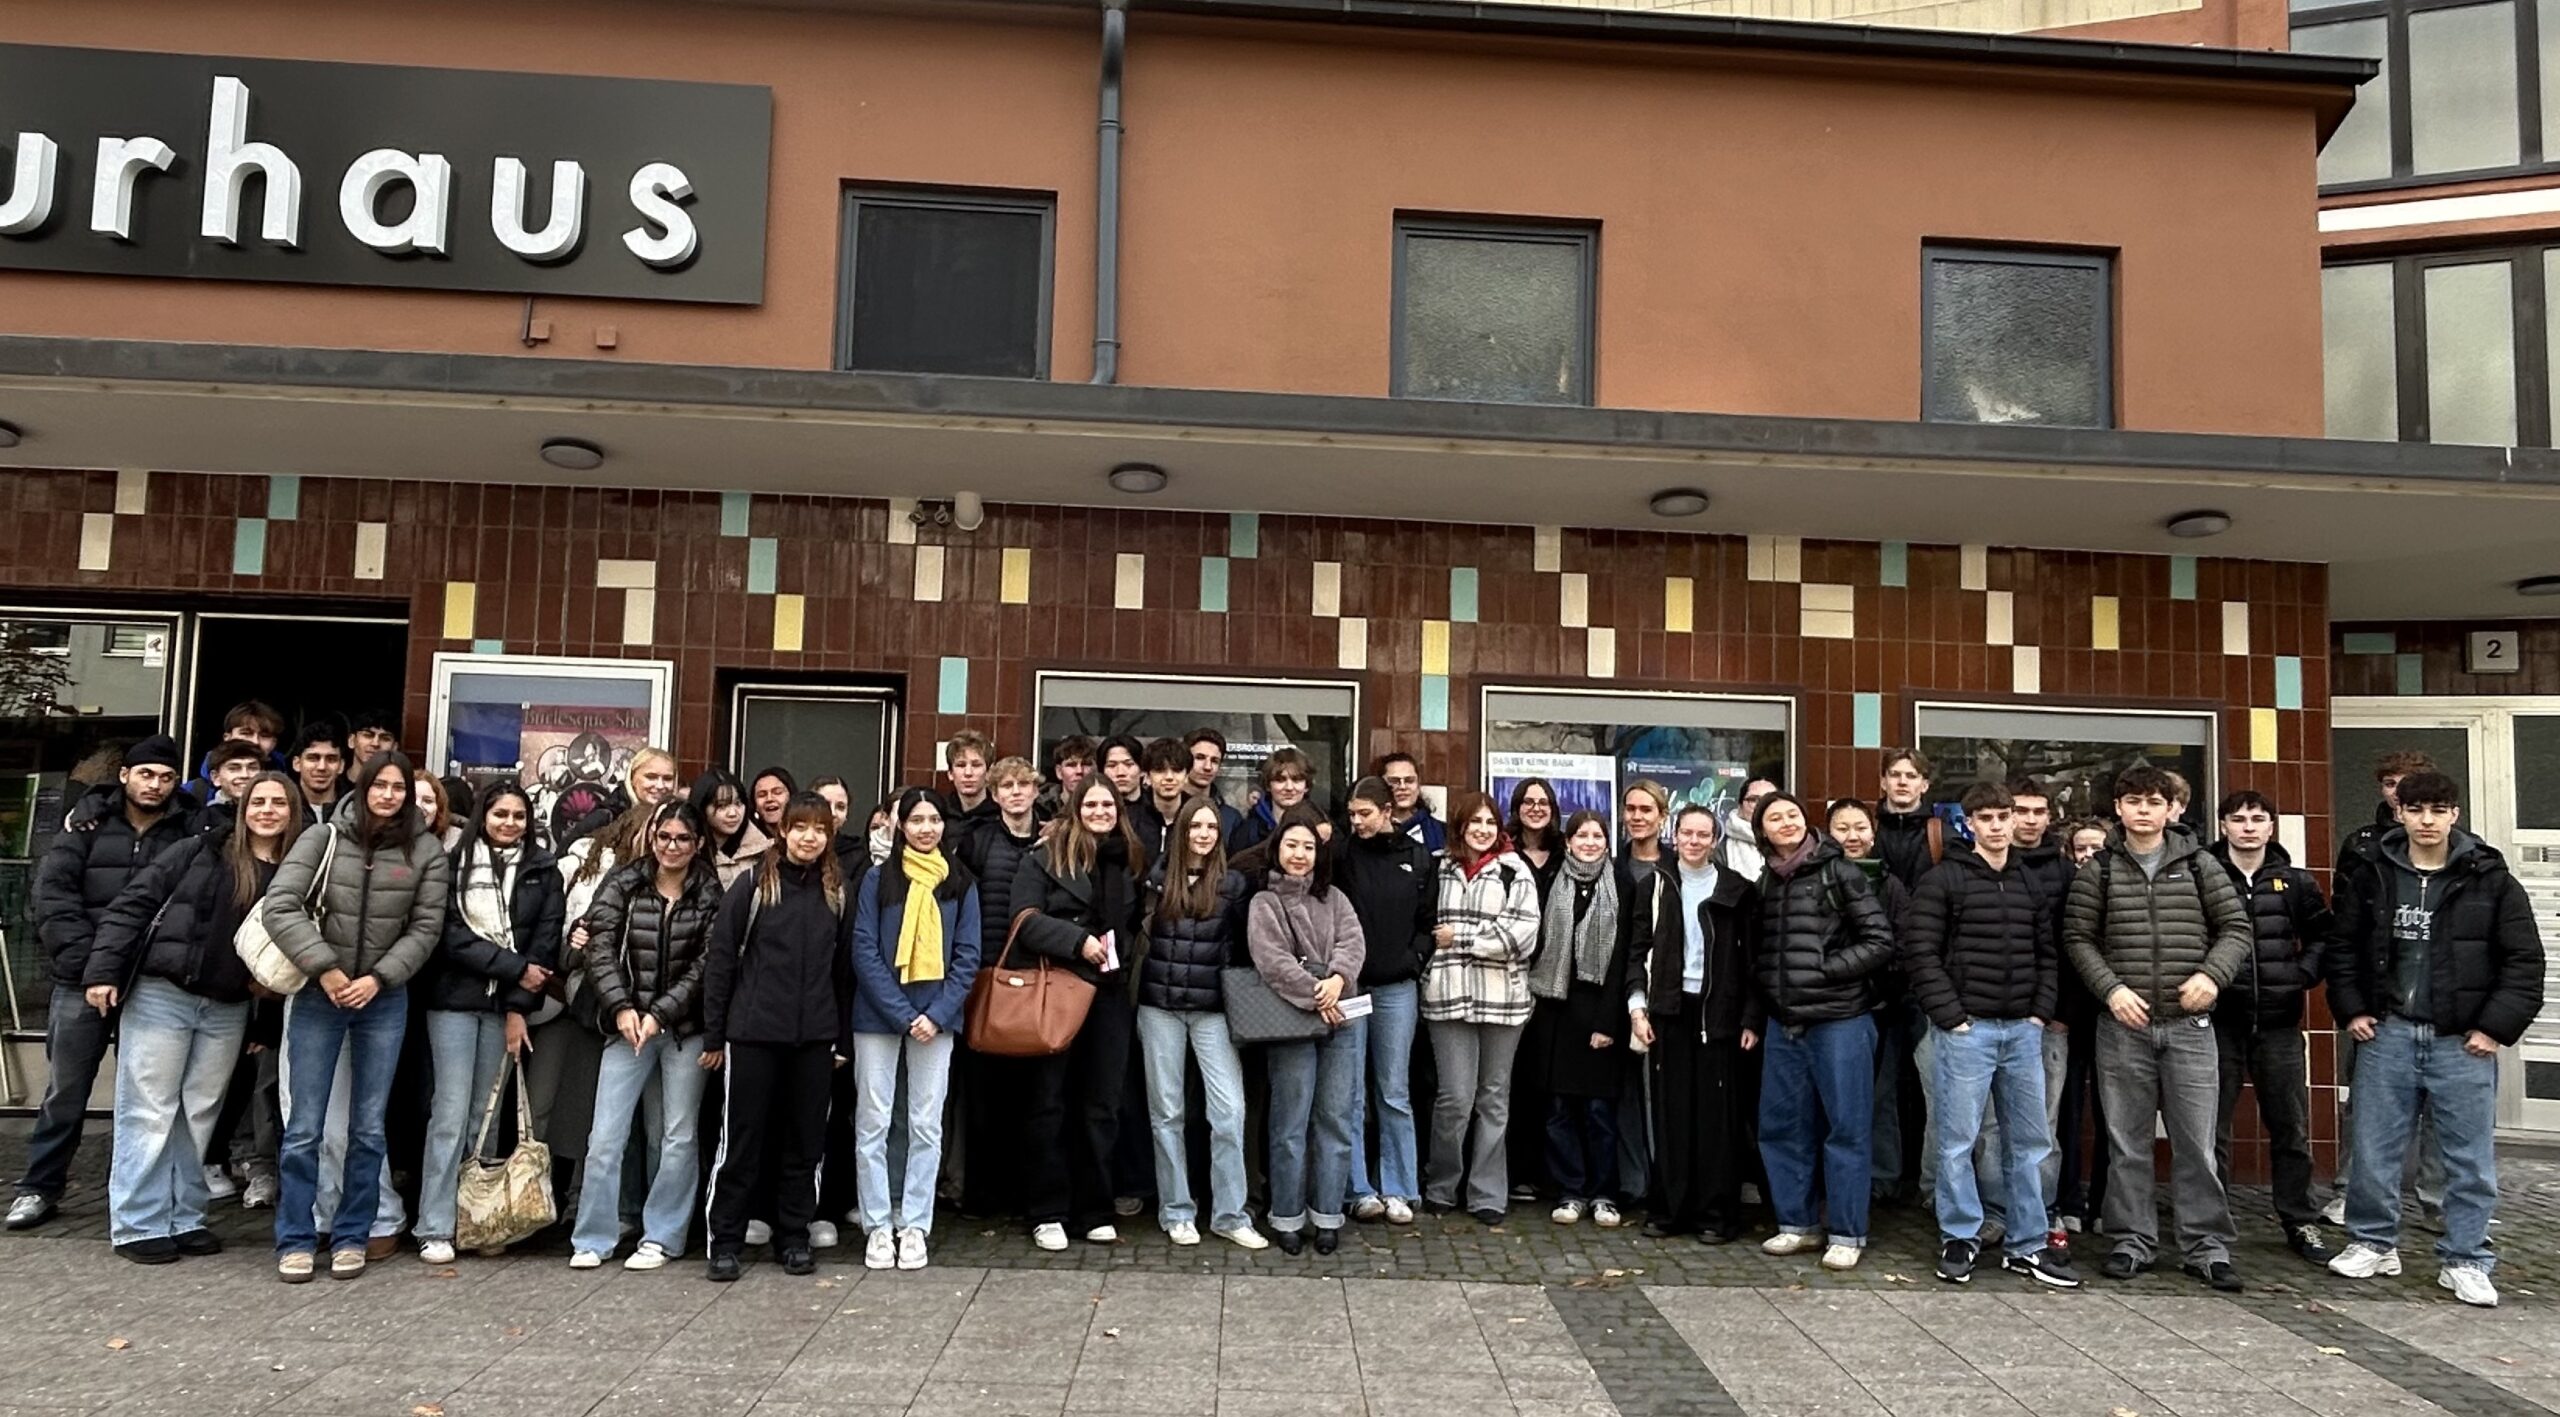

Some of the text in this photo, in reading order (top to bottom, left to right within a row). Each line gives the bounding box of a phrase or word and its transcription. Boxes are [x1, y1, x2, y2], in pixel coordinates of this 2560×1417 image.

[2486, 639, 2502, 659] 2
[524, 708, 649, 731] Burlesque Sho
[1511, 757, 1524, 767] IST
